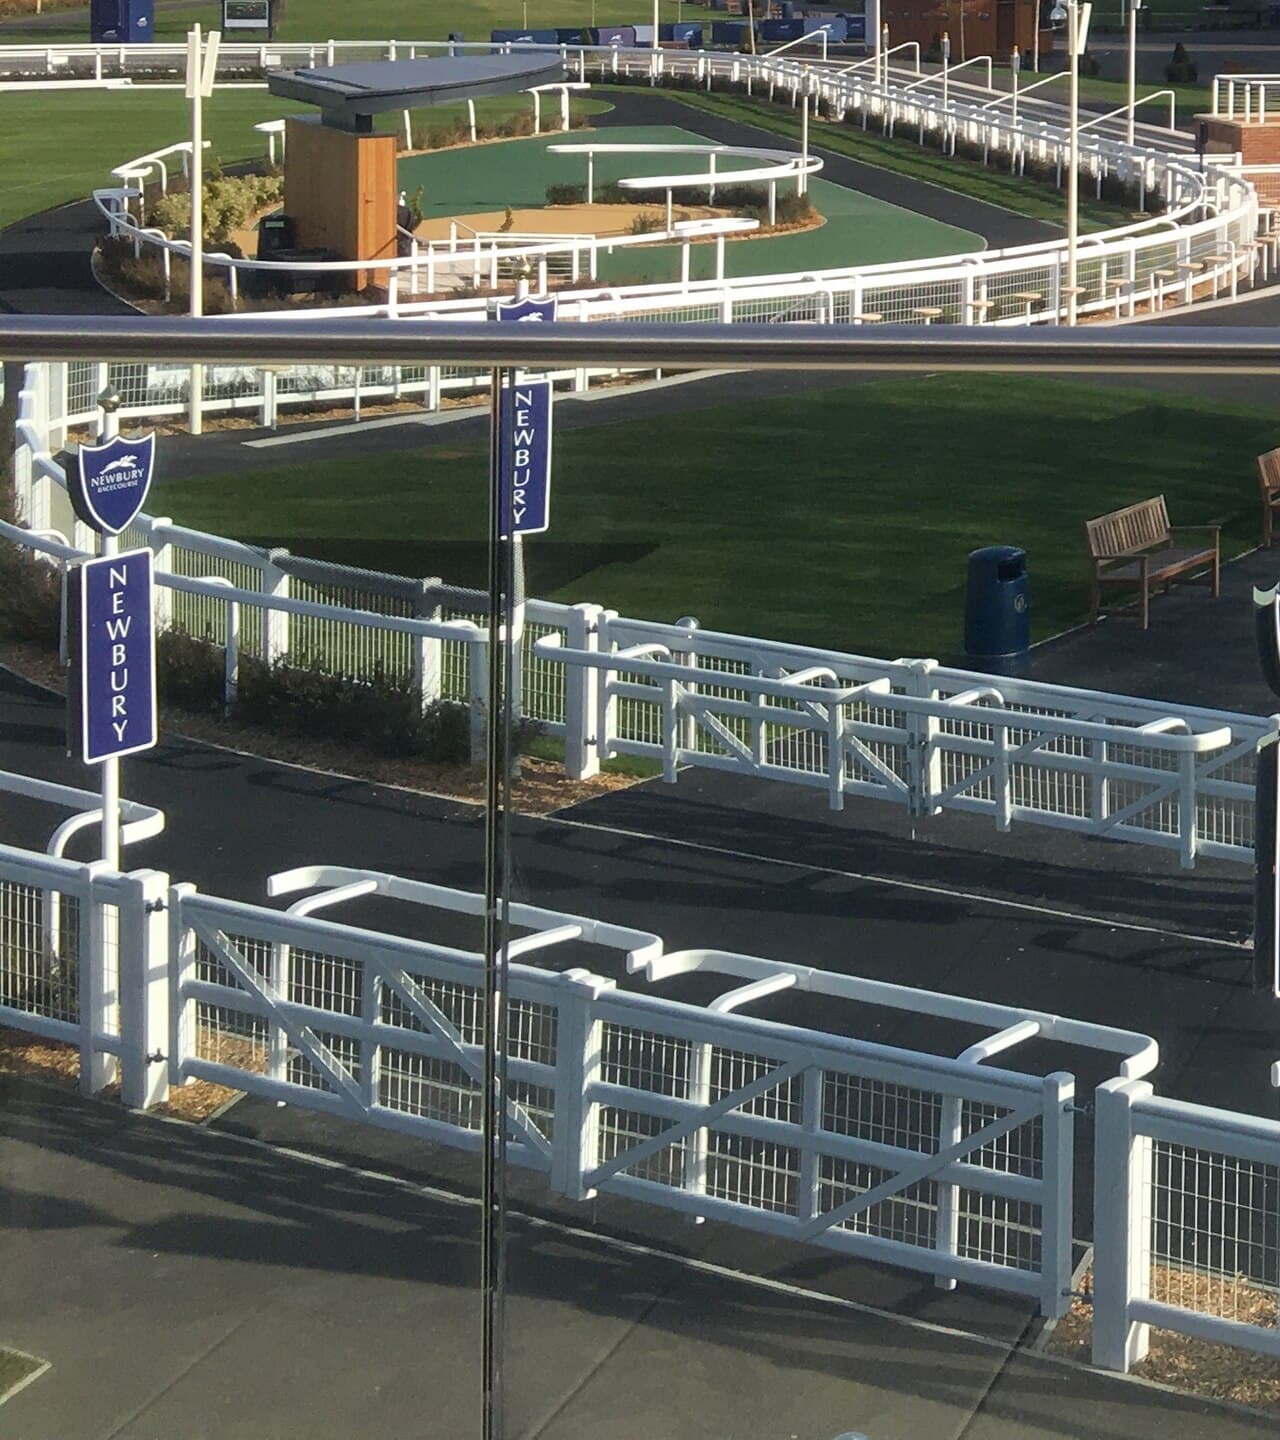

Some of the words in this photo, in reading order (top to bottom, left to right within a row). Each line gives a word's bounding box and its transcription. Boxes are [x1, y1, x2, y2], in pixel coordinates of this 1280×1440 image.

[91, 467, 145, 488] NEWBURY
[512, 389, 535, 525] NEWBURY
[105, 563, 132, 743] NEWBURY
